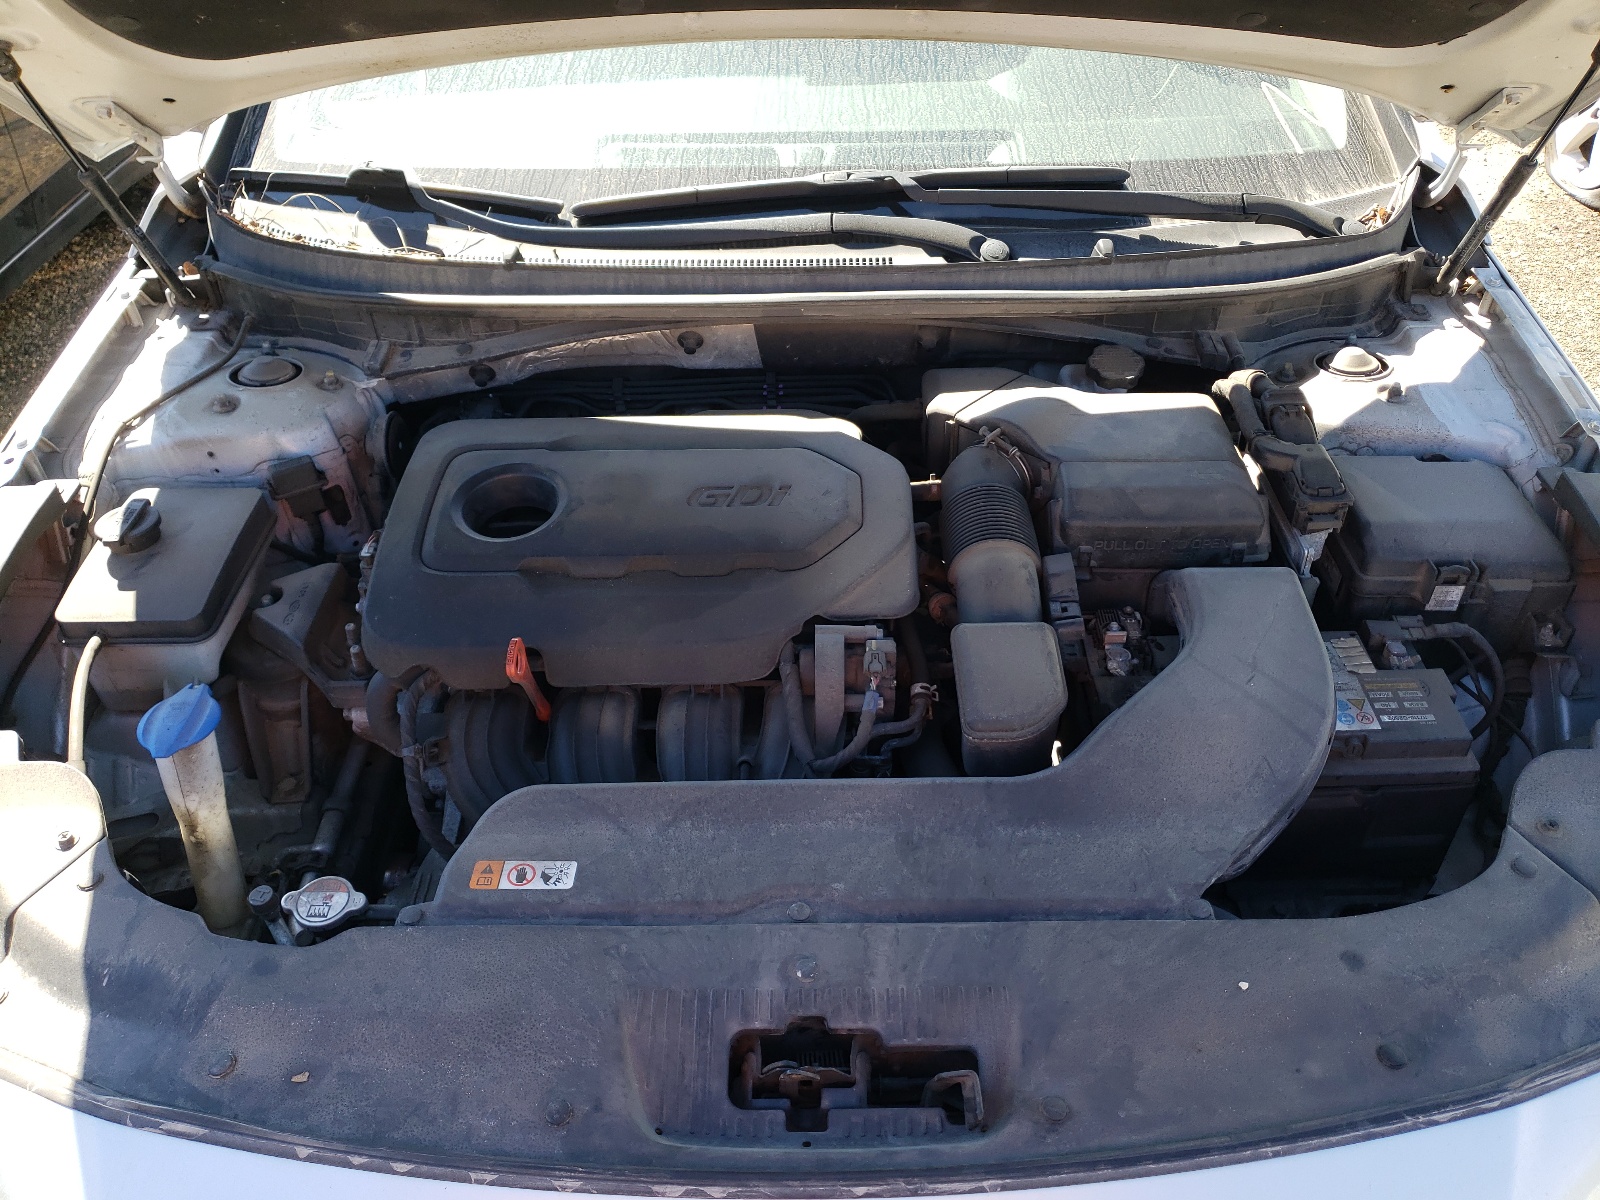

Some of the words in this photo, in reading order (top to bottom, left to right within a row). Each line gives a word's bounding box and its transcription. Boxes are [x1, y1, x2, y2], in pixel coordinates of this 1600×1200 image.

[1094, 540, 1131, 550] PULL
[1135, 540, 1166, 550] OUT
[1191, 538, 1229, 549] OPEN
